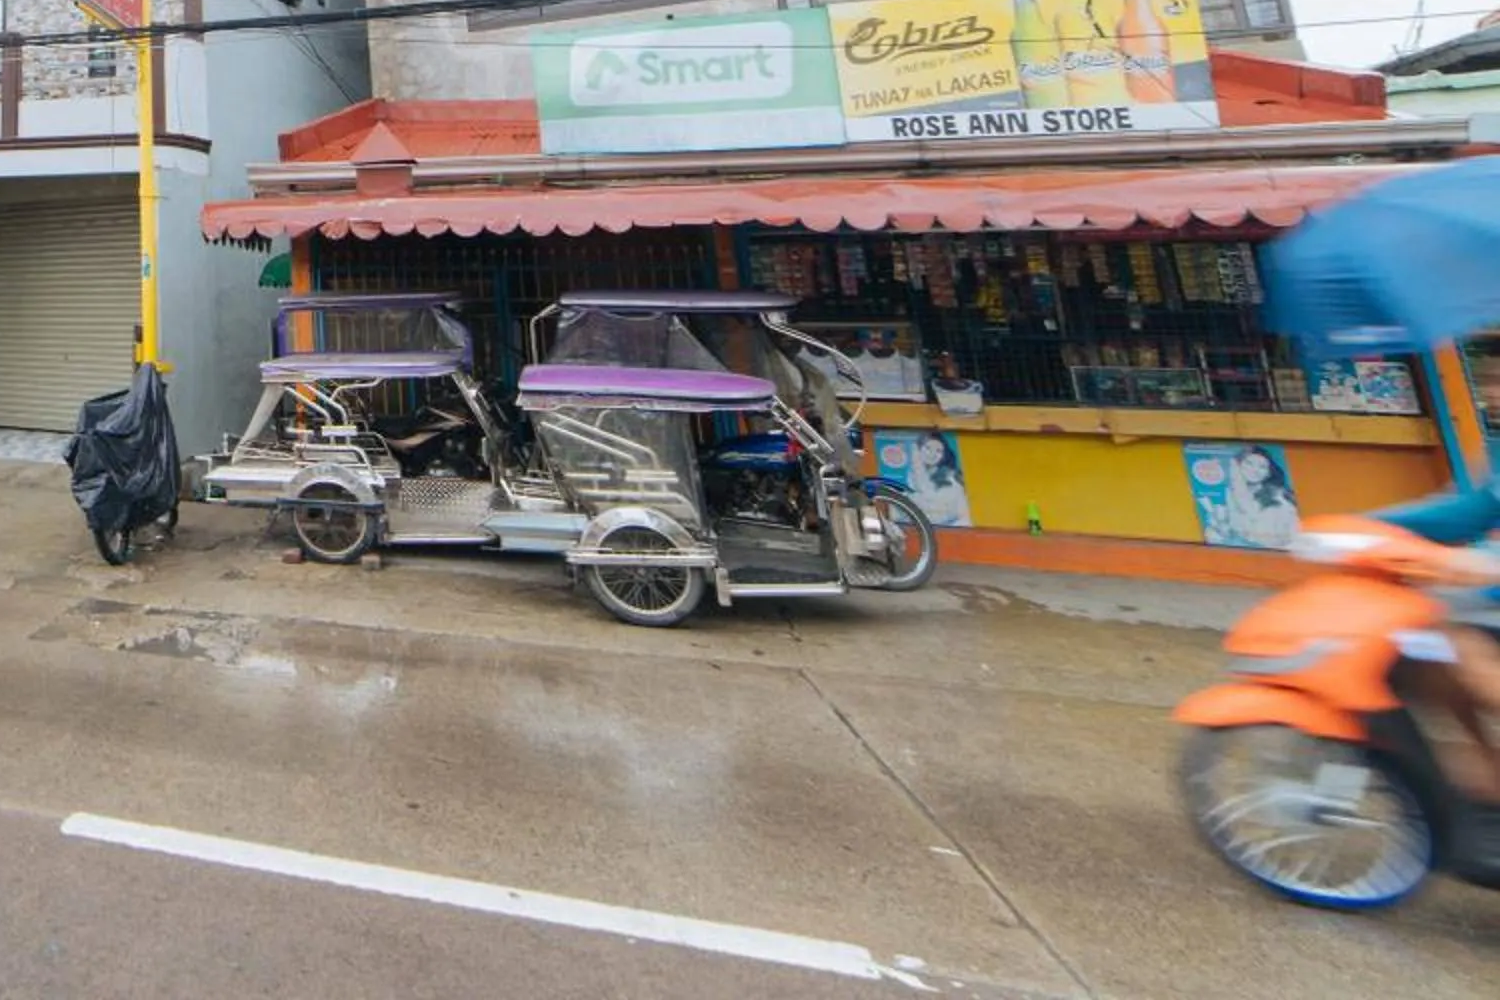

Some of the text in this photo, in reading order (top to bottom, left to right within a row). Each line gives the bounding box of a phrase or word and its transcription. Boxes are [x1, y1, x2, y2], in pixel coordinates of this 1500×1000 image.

[845, 16, 995, 65] Cobra
[637, 45, 775, 85] Smart
[937, 69, 1012, 96] LAKAS!
[891, 107, 1133, 138] ROSE ANN STORE
